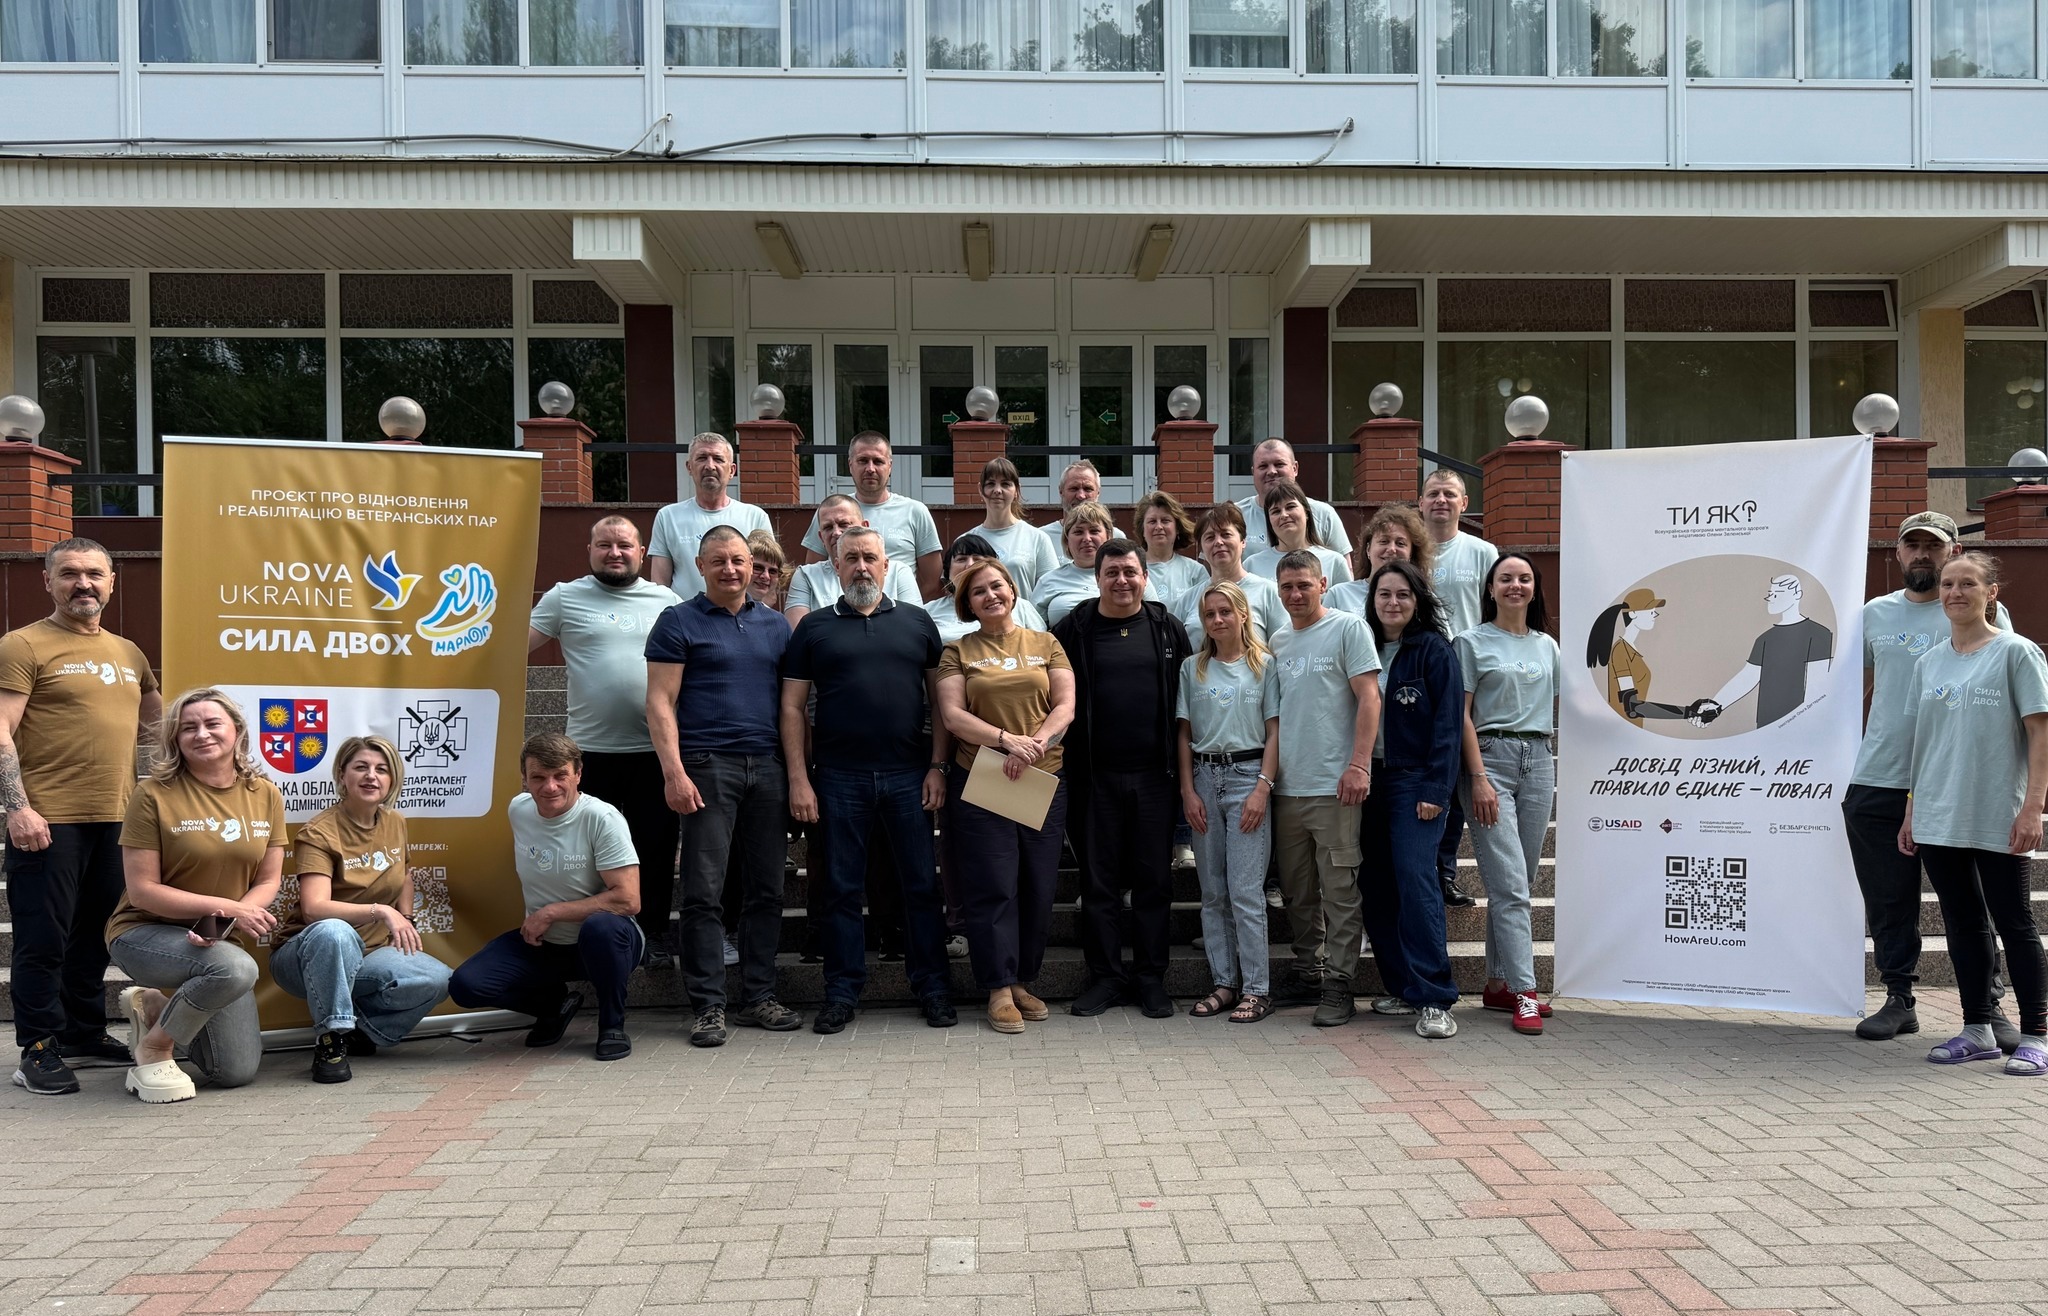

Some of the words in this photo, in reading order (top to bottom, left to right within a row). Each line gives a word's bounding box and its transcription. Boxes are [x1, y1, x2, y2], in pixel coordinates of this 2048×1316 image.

[251, 489, 316, 503] ПРОЄКТ
[320, 491, 354, 505] ПРО
[358, 493, 469, 510] ВІДНОВЛЕННЯ
[219, 505, 223, 516] І
[228, 505, 342, 520] РЕАБІЛІТАЦІЮ
[346, 509, 465, 526] ВЕТЕРАНСЬКИХ
[468, 514, 498, 528] ПАР
[1666, 506, 1699, 525] ТИ
[263, 561, 354, 583] NOVA
[219, 584, 354, 608] UKRAINE
[219, 628, 317, 653] СИЛА
[323, 631, 413, 659] ДВОХ
[1974, 687, 2002, 697] СИЛА
[1972, 697, 2000, 707] ДВОХ
[1773, 758, 1814, 776] АЛЕ
[403, 775, 467, 786] ЕПАРТАМЕНТ
[400, 785, 466, 798] ЕТЕРАНСЬКОЇ
[1589, 779, 1670, 797] ПРАВИЛО
[1675, 781, 1746, 800] ЄДИНЕ
[1765, 782, 1834, 800] ПОВАГА
[393, 799, 446, 810] ПОЛІТИКИ
[1605, 819, 1642, 828] USAID
[563, 863, 587, 871] ДВОХ
[1664, 934, 1746, 947] HowAreU.com
